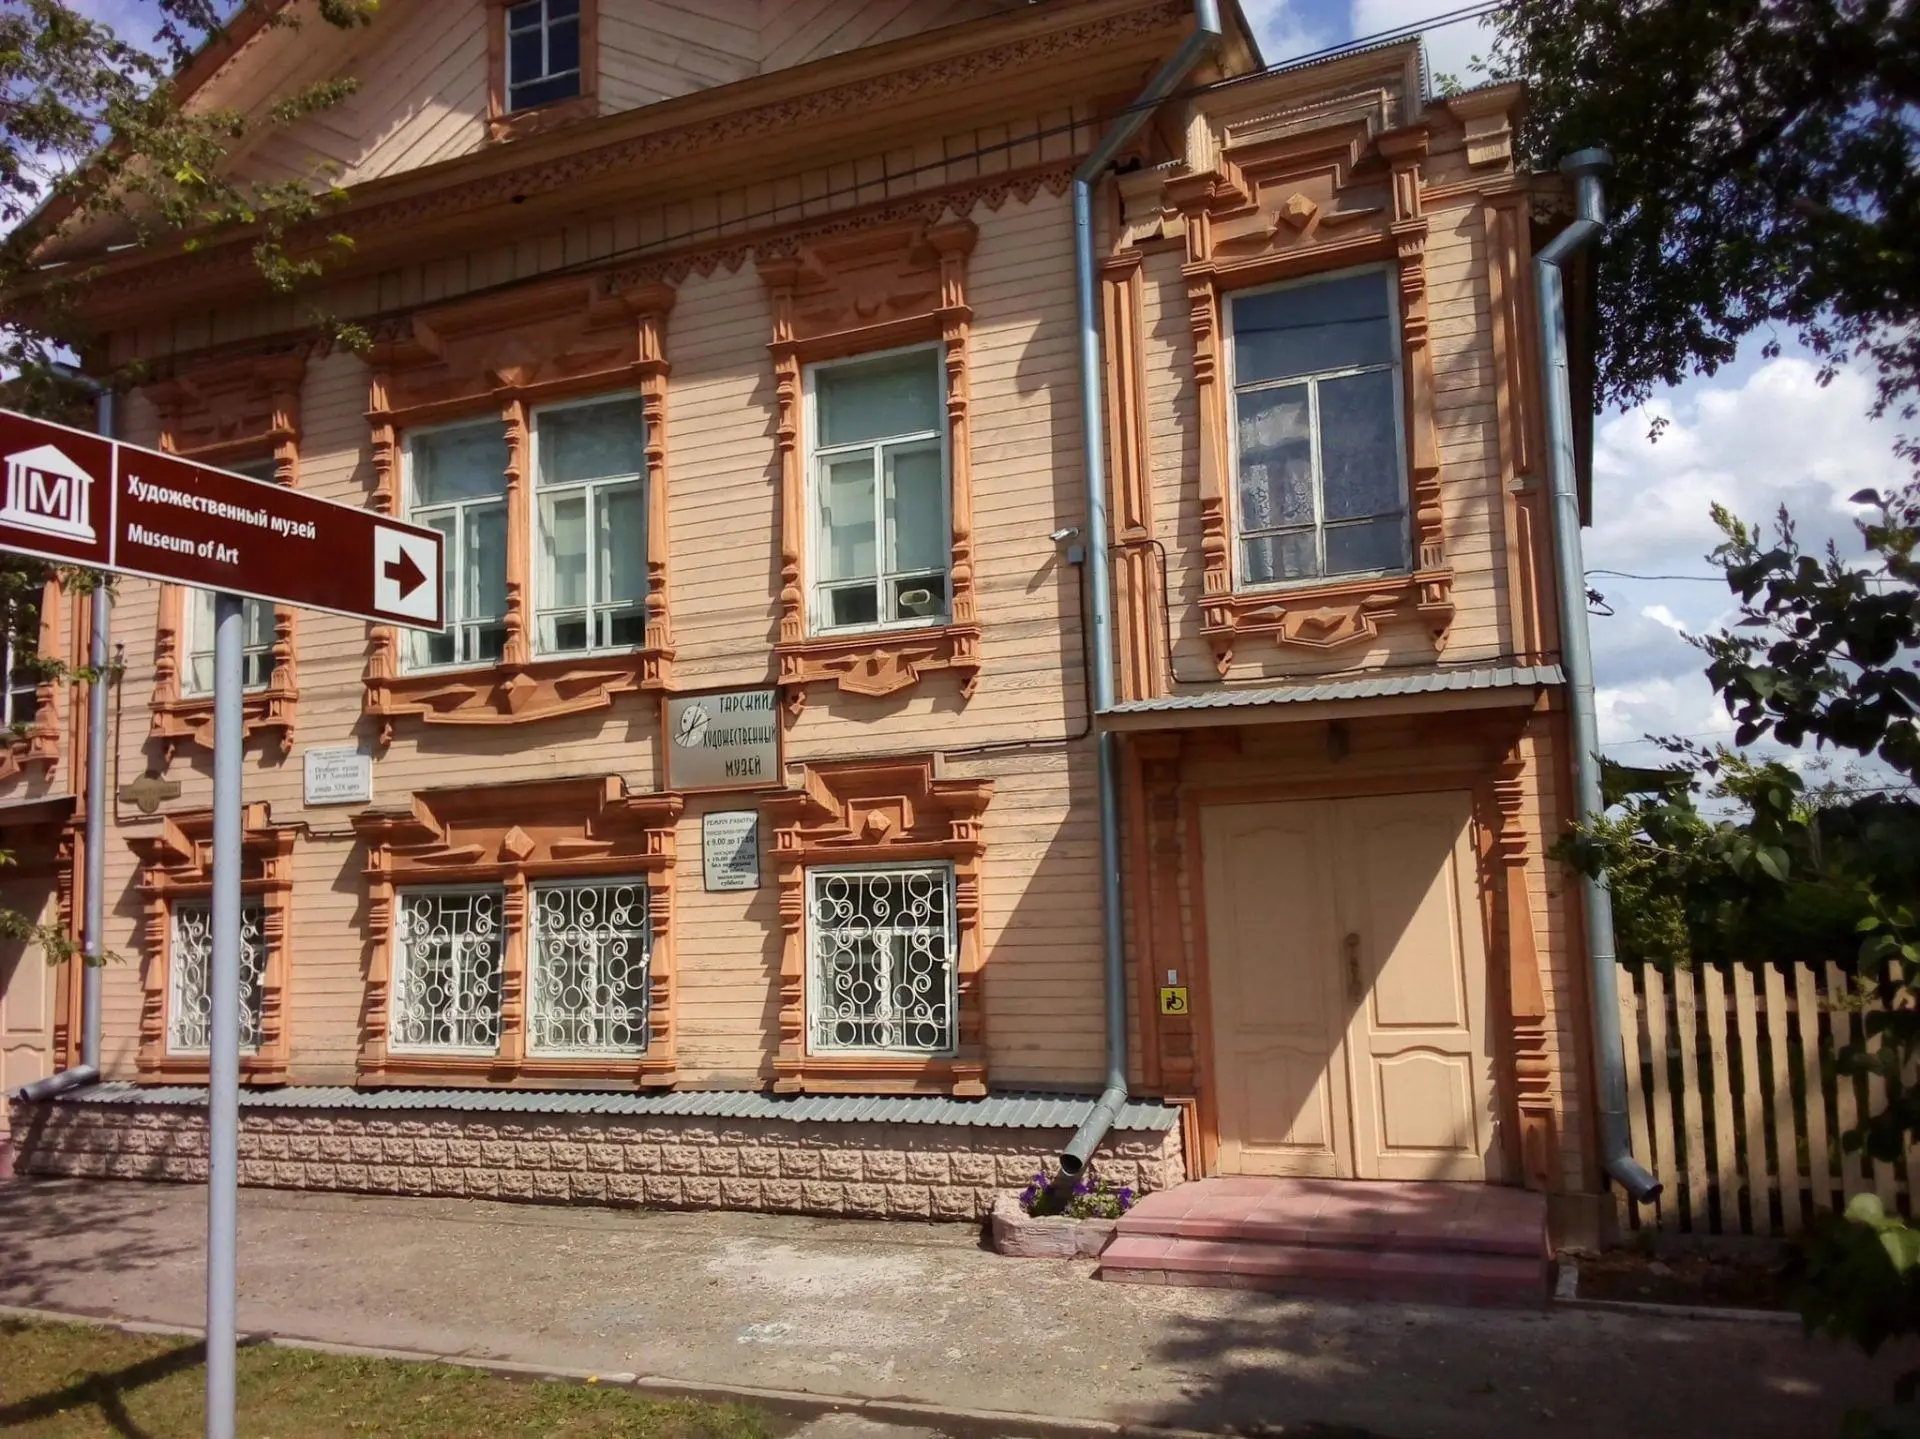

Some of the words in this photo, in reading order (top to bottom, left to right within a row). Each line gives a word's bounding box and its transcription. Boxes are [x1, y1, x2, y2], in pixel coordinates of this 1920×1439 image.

[128, 474, 267, 528] Художественный
[271, 516, 316, 539] музей
[128, 523, 194, 555] Museum
[198, 541, 214, 558] of
[216, 543, 239, 564] Art
[720, 692, 769, 713] ТАРСКИЙ
[703, 723, 776, 749] ХУДОЖЕСТВЕННЫЙ
[725, 755, 761, 777] МУЗЕЙ
